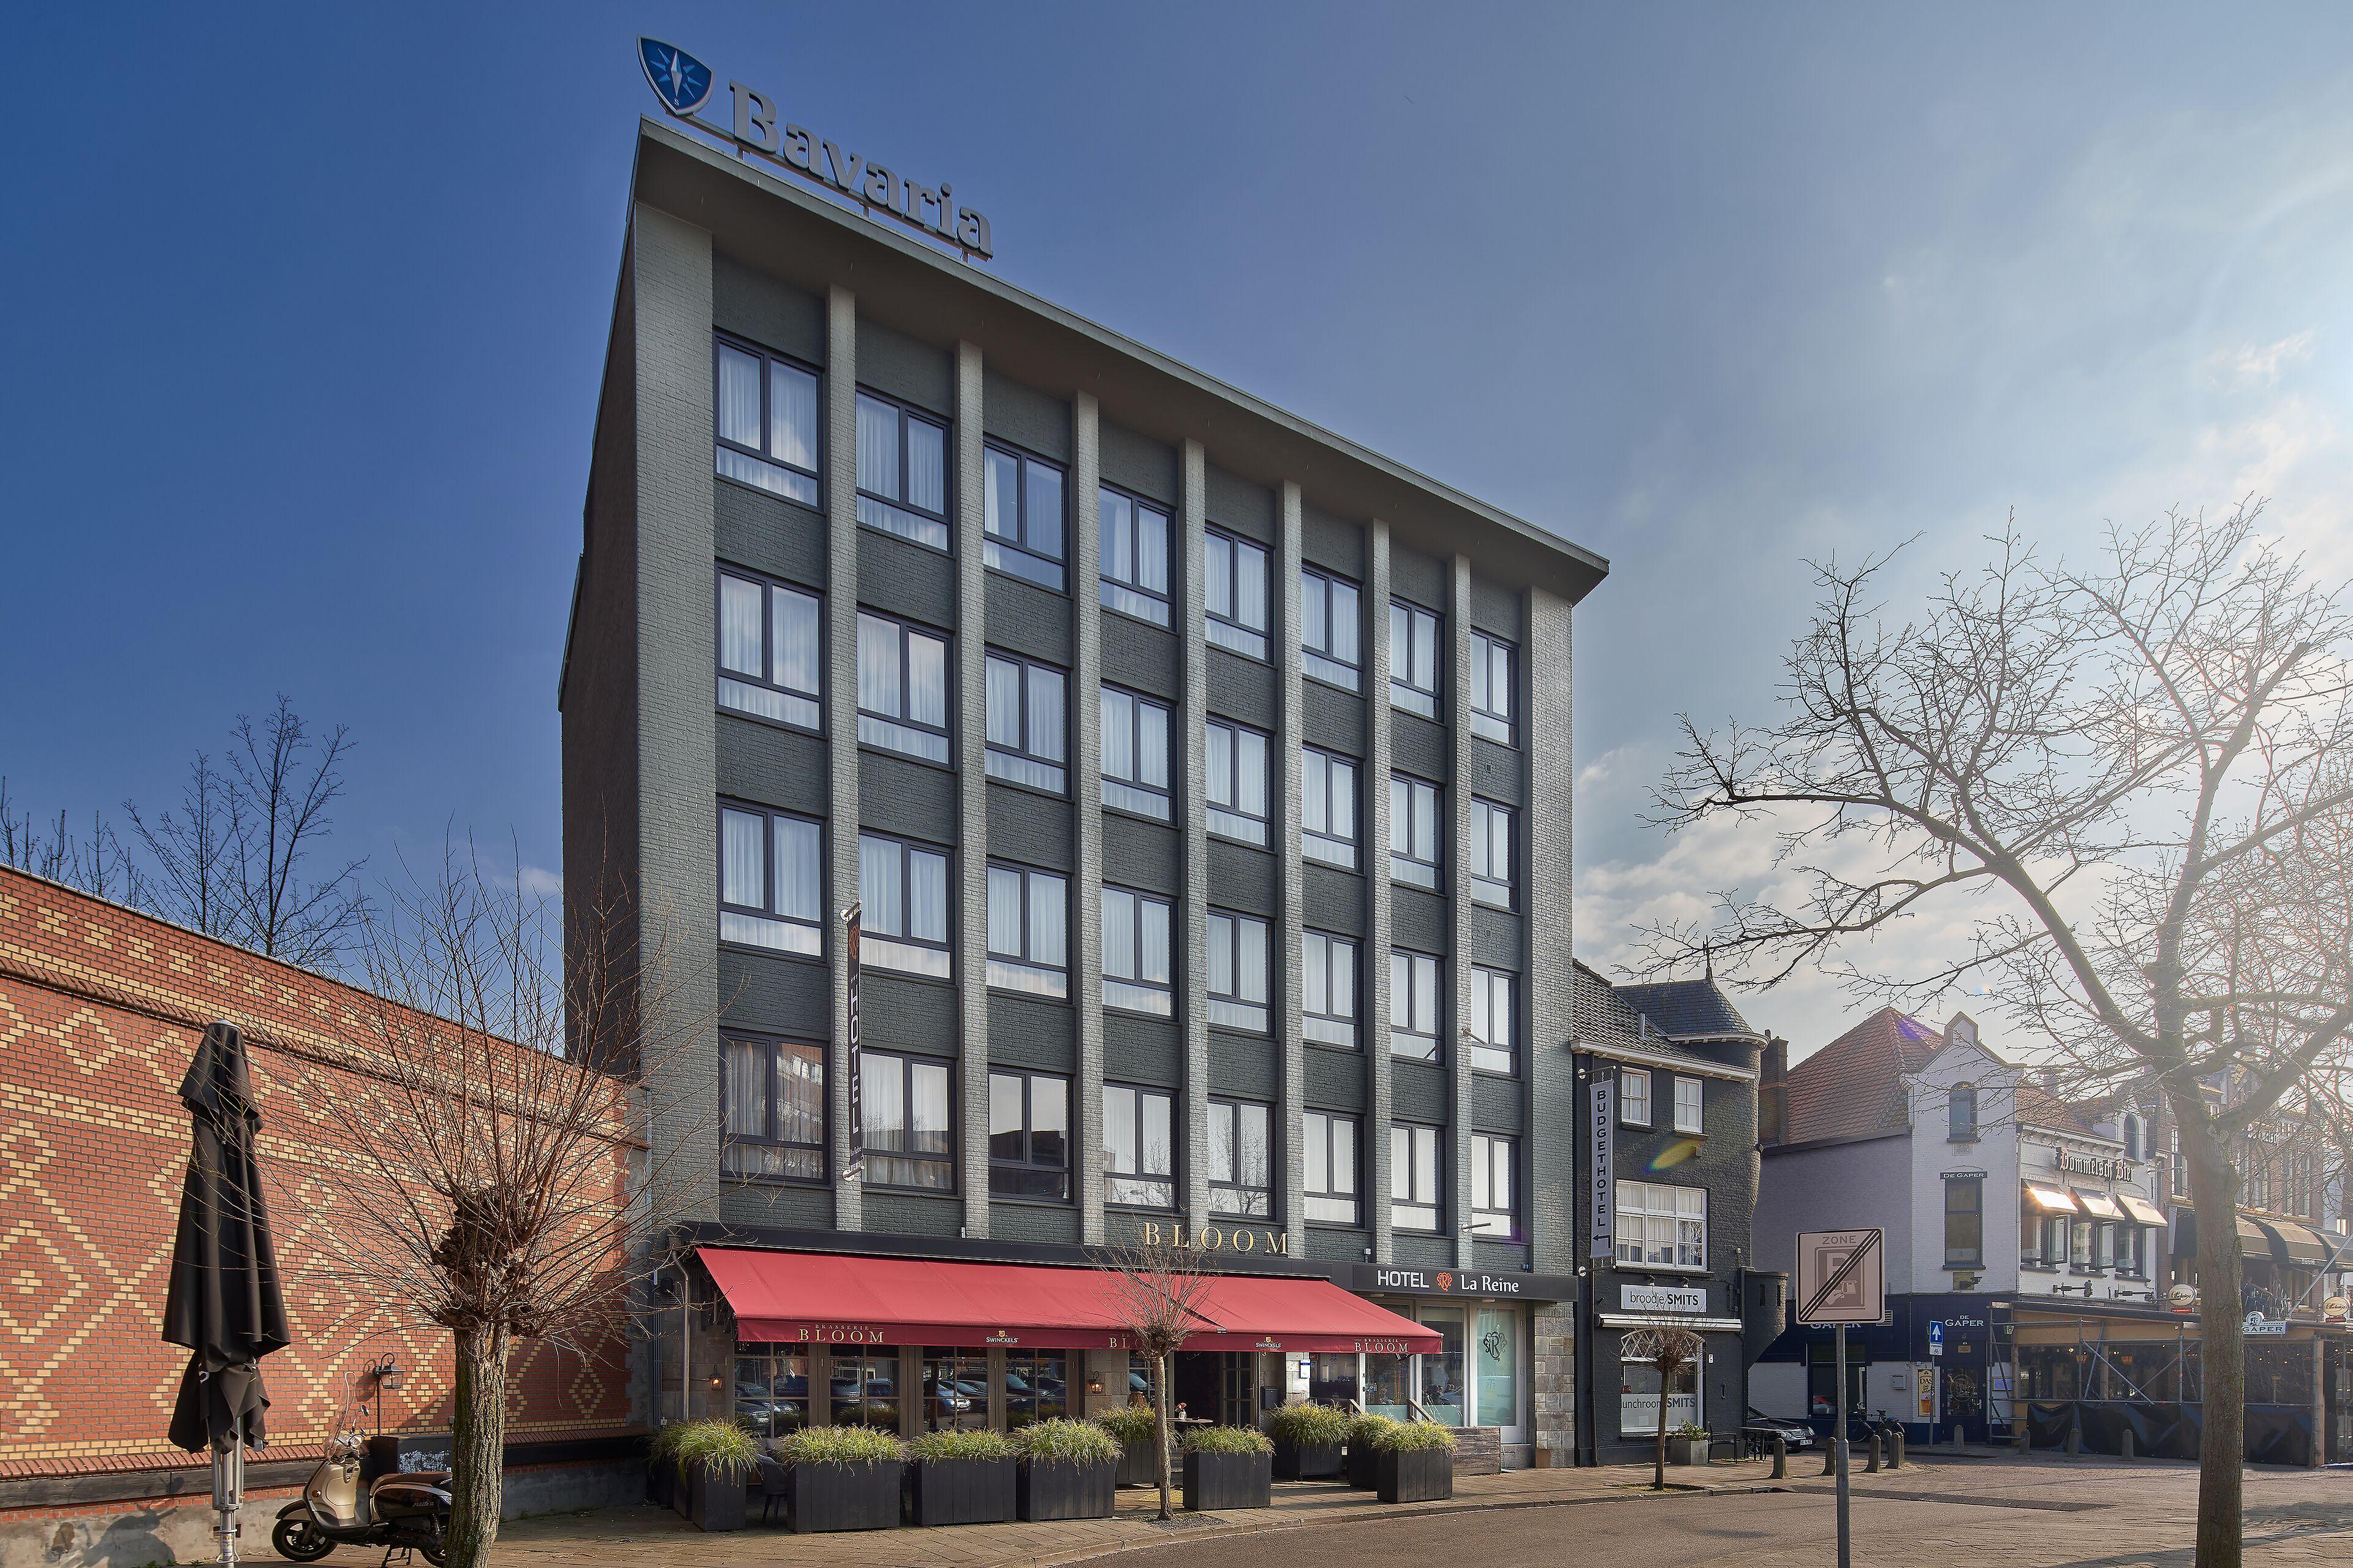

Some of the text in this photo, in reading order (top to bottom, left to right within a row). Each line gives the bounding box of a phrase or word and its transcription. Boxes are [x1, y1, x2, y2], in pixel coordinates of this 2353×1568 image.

[729, 79, 993, 259] Bavaria
[1597, 1090, 1607, 1227] BUDGETHOTEL
[2060, 1147, 2134, 1182] Dommelsch Bier
[1144, 1222, 1288, 1254] BLOOM
[1822, 1235, 1857, 1244] ZONE
[1377, 1270, 1520, 1292] HOTEL La Reine
[1630, 1290, 1699, 1307] broodje SMITS
[799, 1328, 884, 1343] BLOOM
[1354, 1342, 1408, 1352] BLOOM
[1667, 1398, 1695, 1408] SMITS
